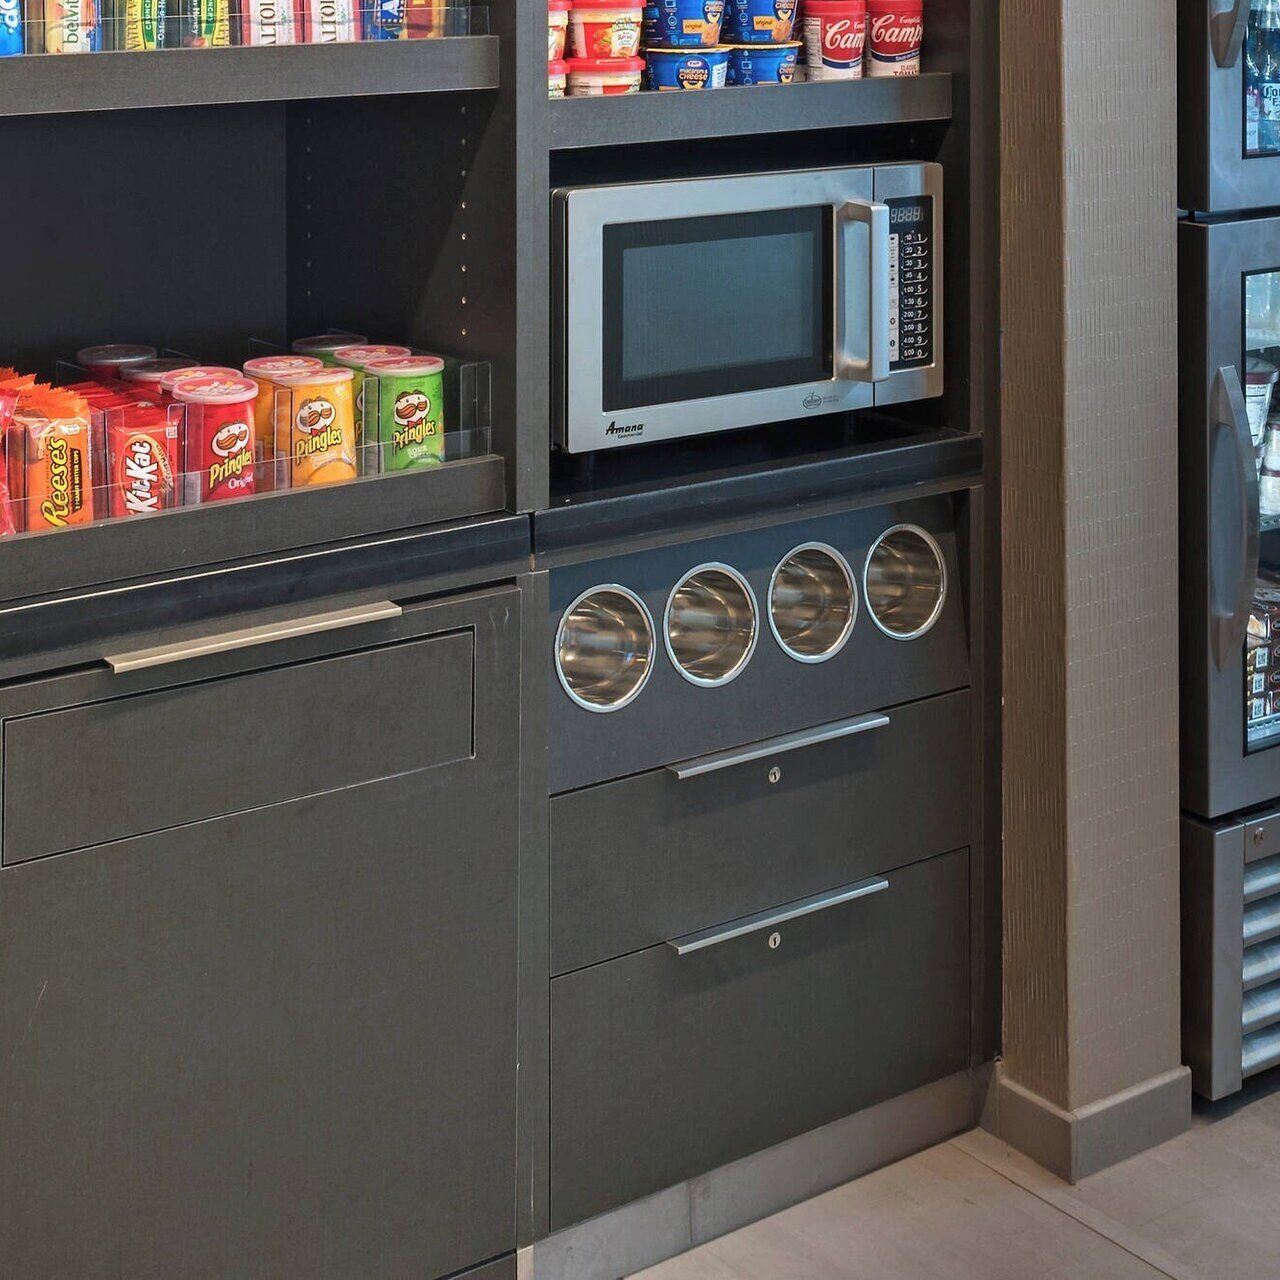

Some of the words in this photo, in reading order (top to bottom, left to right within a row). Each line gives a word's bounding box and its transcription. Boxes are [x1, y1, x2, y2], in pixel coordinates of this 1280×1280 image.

[126, 10, 140, 50] NATURE
[295, 425, 342, 463] Pringles
[394, 418, 435, 452] Pringles
[606, 421, 645, 436] Amana
[40, 435, 69, 527] Reese's
[208, 447, 253, 489] Pringles
